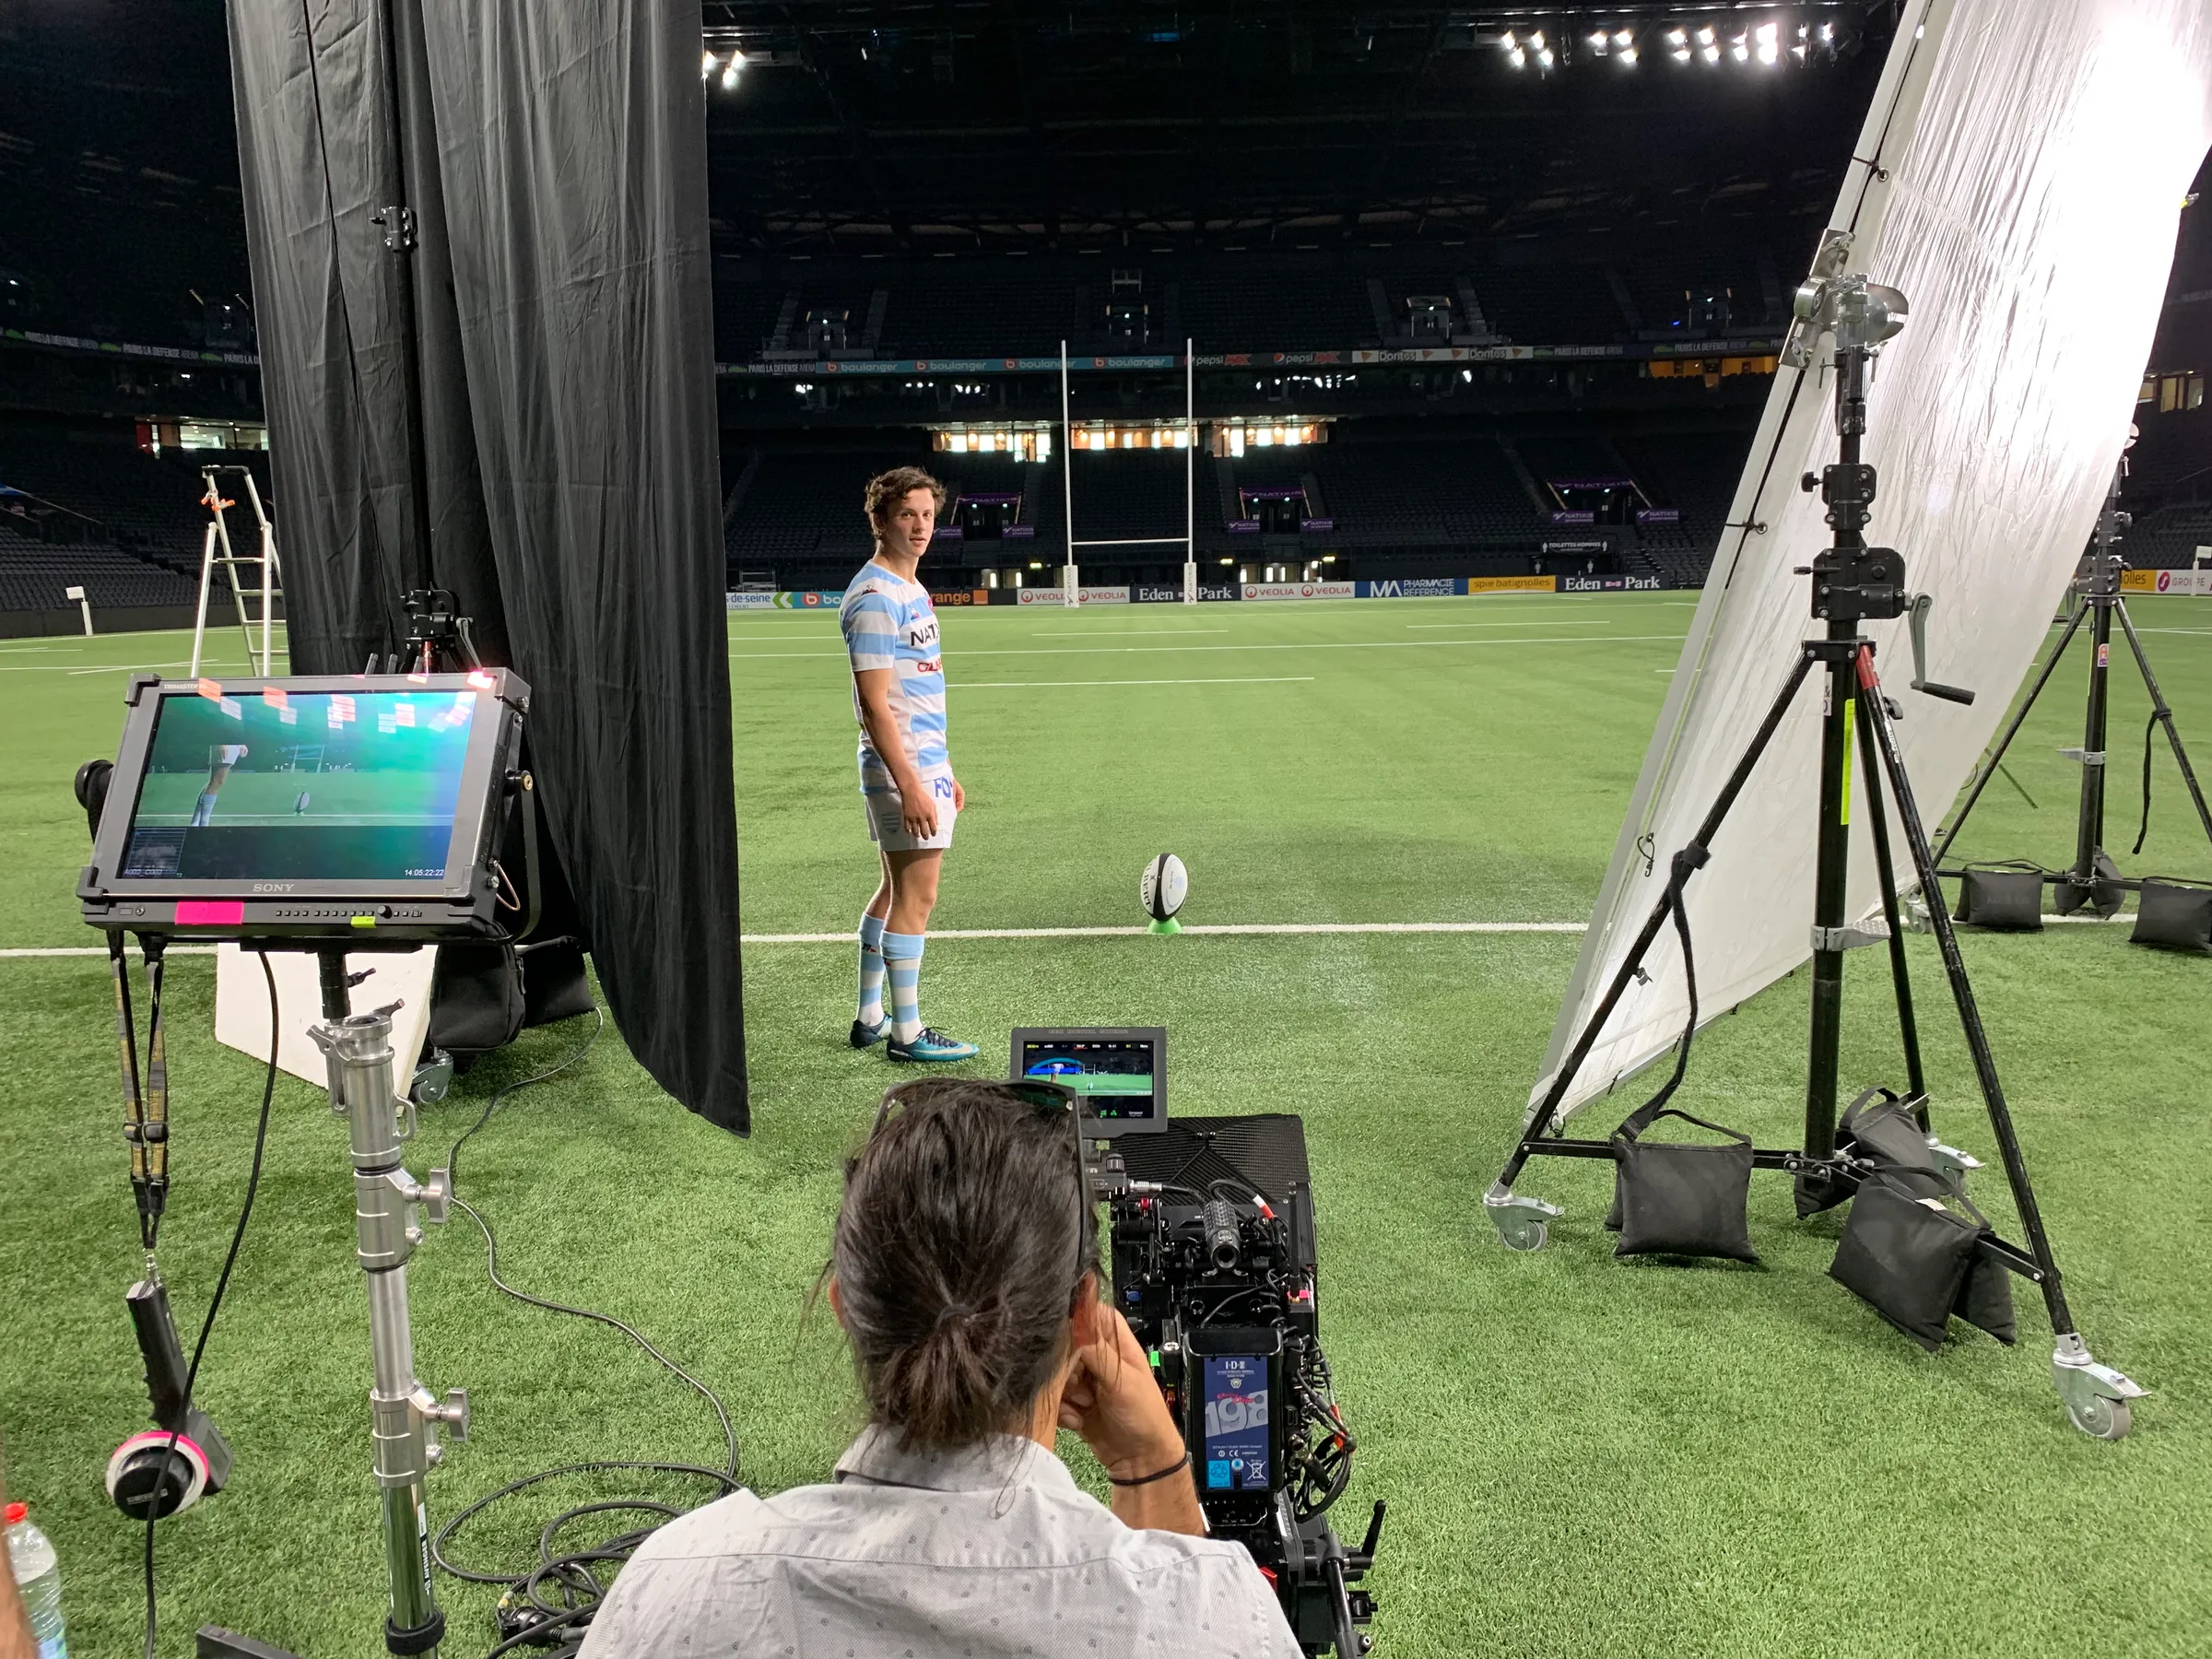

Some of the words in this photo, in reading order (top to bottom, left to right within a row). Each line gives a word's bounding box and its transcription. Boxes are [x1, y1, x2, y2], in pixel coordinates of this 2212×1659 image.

[1286, 353, 1313, 364] pepsi
[1379, 350, 1417, 362] Doritos
[1469, 347, 1507, 360] Doritos
[930, 360, 987, 371] boulanger
[1109, 357, 1165, 369] boulanger
[1196, 356, 1223, 366] pepsi
[841, 362, 898, 373] boulanger
[1404, 578, 1454, 588] PHARMACIE
[1474, 578, 1494, 590] spie
[1496, 576, 1550, 589] batignolles
[1565, 577, 1601, 591] Eden
[1625, 575, 1660, 589] Park
[1139, 587, 1173, 601] Eden
[1198, 586, 1232, 599] Park
[1259, 587, 1294, 596] VEOLIA
[1316, 585, 1351, 594] VEOLIA
[931, 592, 971, 606] range
[1034, 592, 1064, 601] VEOLI
[1090, 591, 1126, 600] VEOLIA
[253, 883, 295, 892] SONY
[421, 1538, 430, 1580] AVENGER
